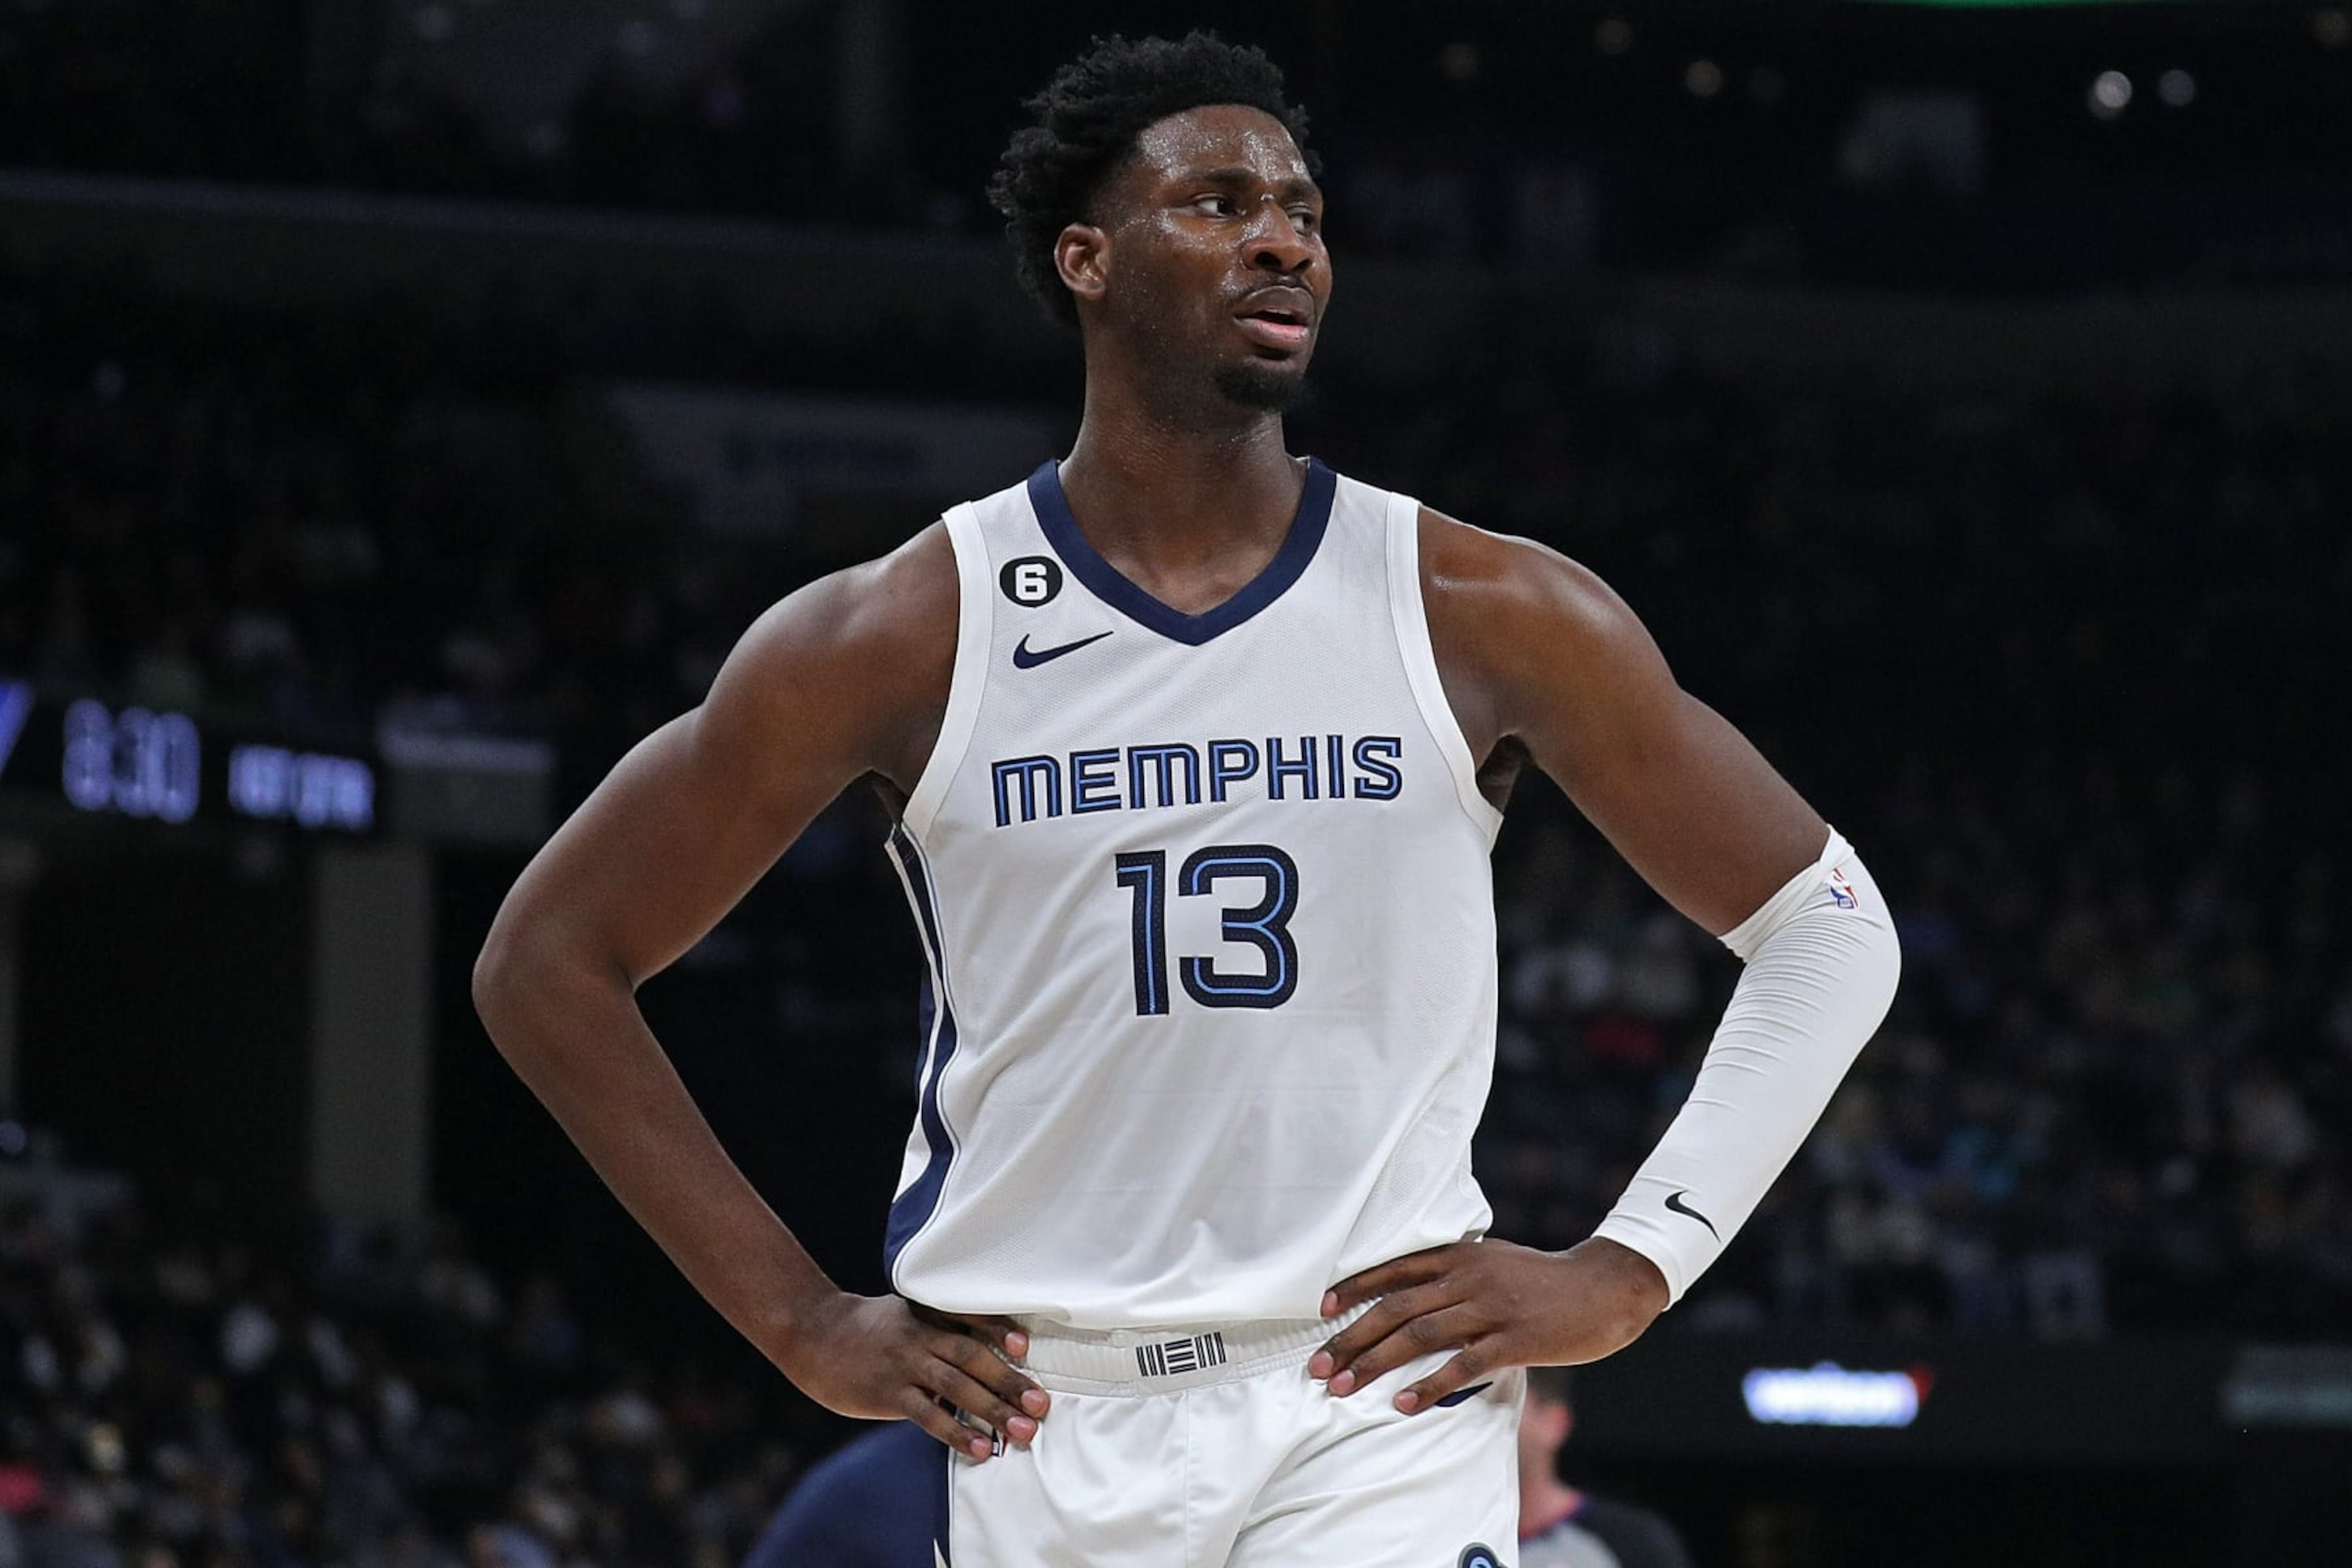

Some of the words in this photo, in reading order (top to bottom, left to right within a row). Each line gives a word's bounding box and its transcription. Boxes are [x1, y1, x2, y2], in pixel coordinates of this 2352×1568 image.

[1015, 563, 1048, 601] 6
[992, 734, 1403, 827] MEMPHIS
[1115, 844, 1298, 1016] 13
